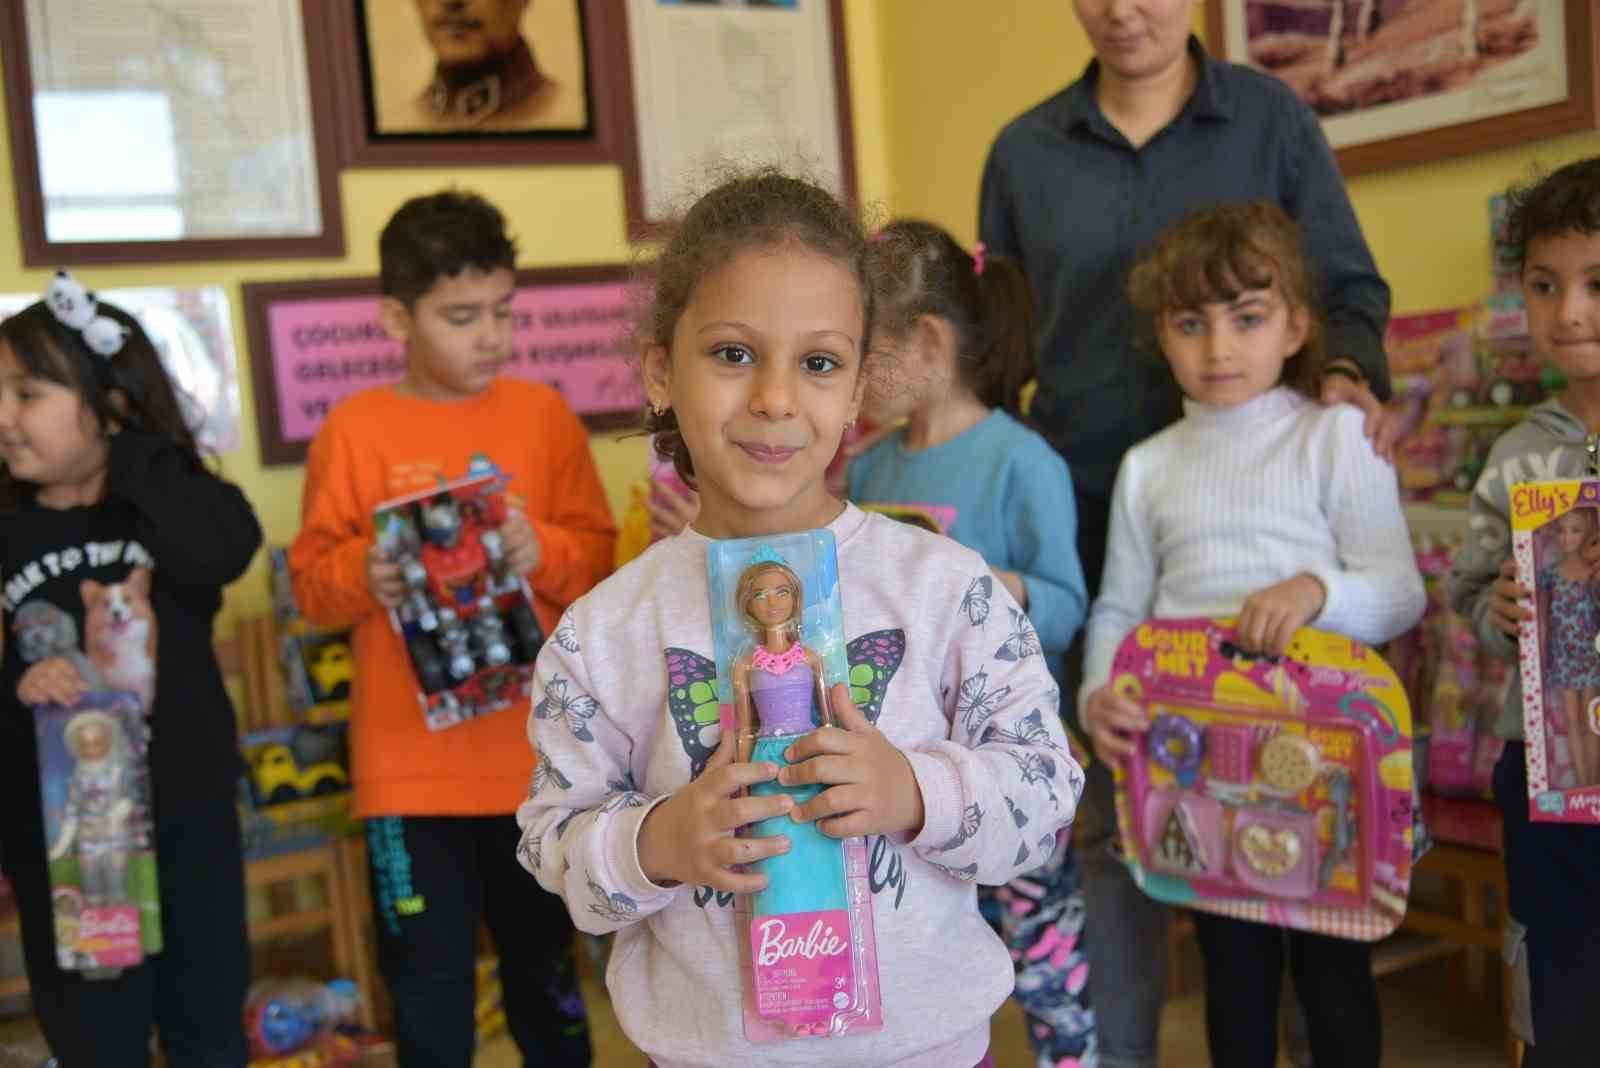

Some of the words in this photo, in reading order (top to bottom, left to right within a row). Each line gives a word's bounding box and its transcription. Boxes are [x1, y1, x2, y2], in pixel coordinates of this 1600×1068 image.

[1513, 486, 1570, 519] Elly's
[42, 551, 83, 577] TO
[758, 919, 848, 966] Barbie
